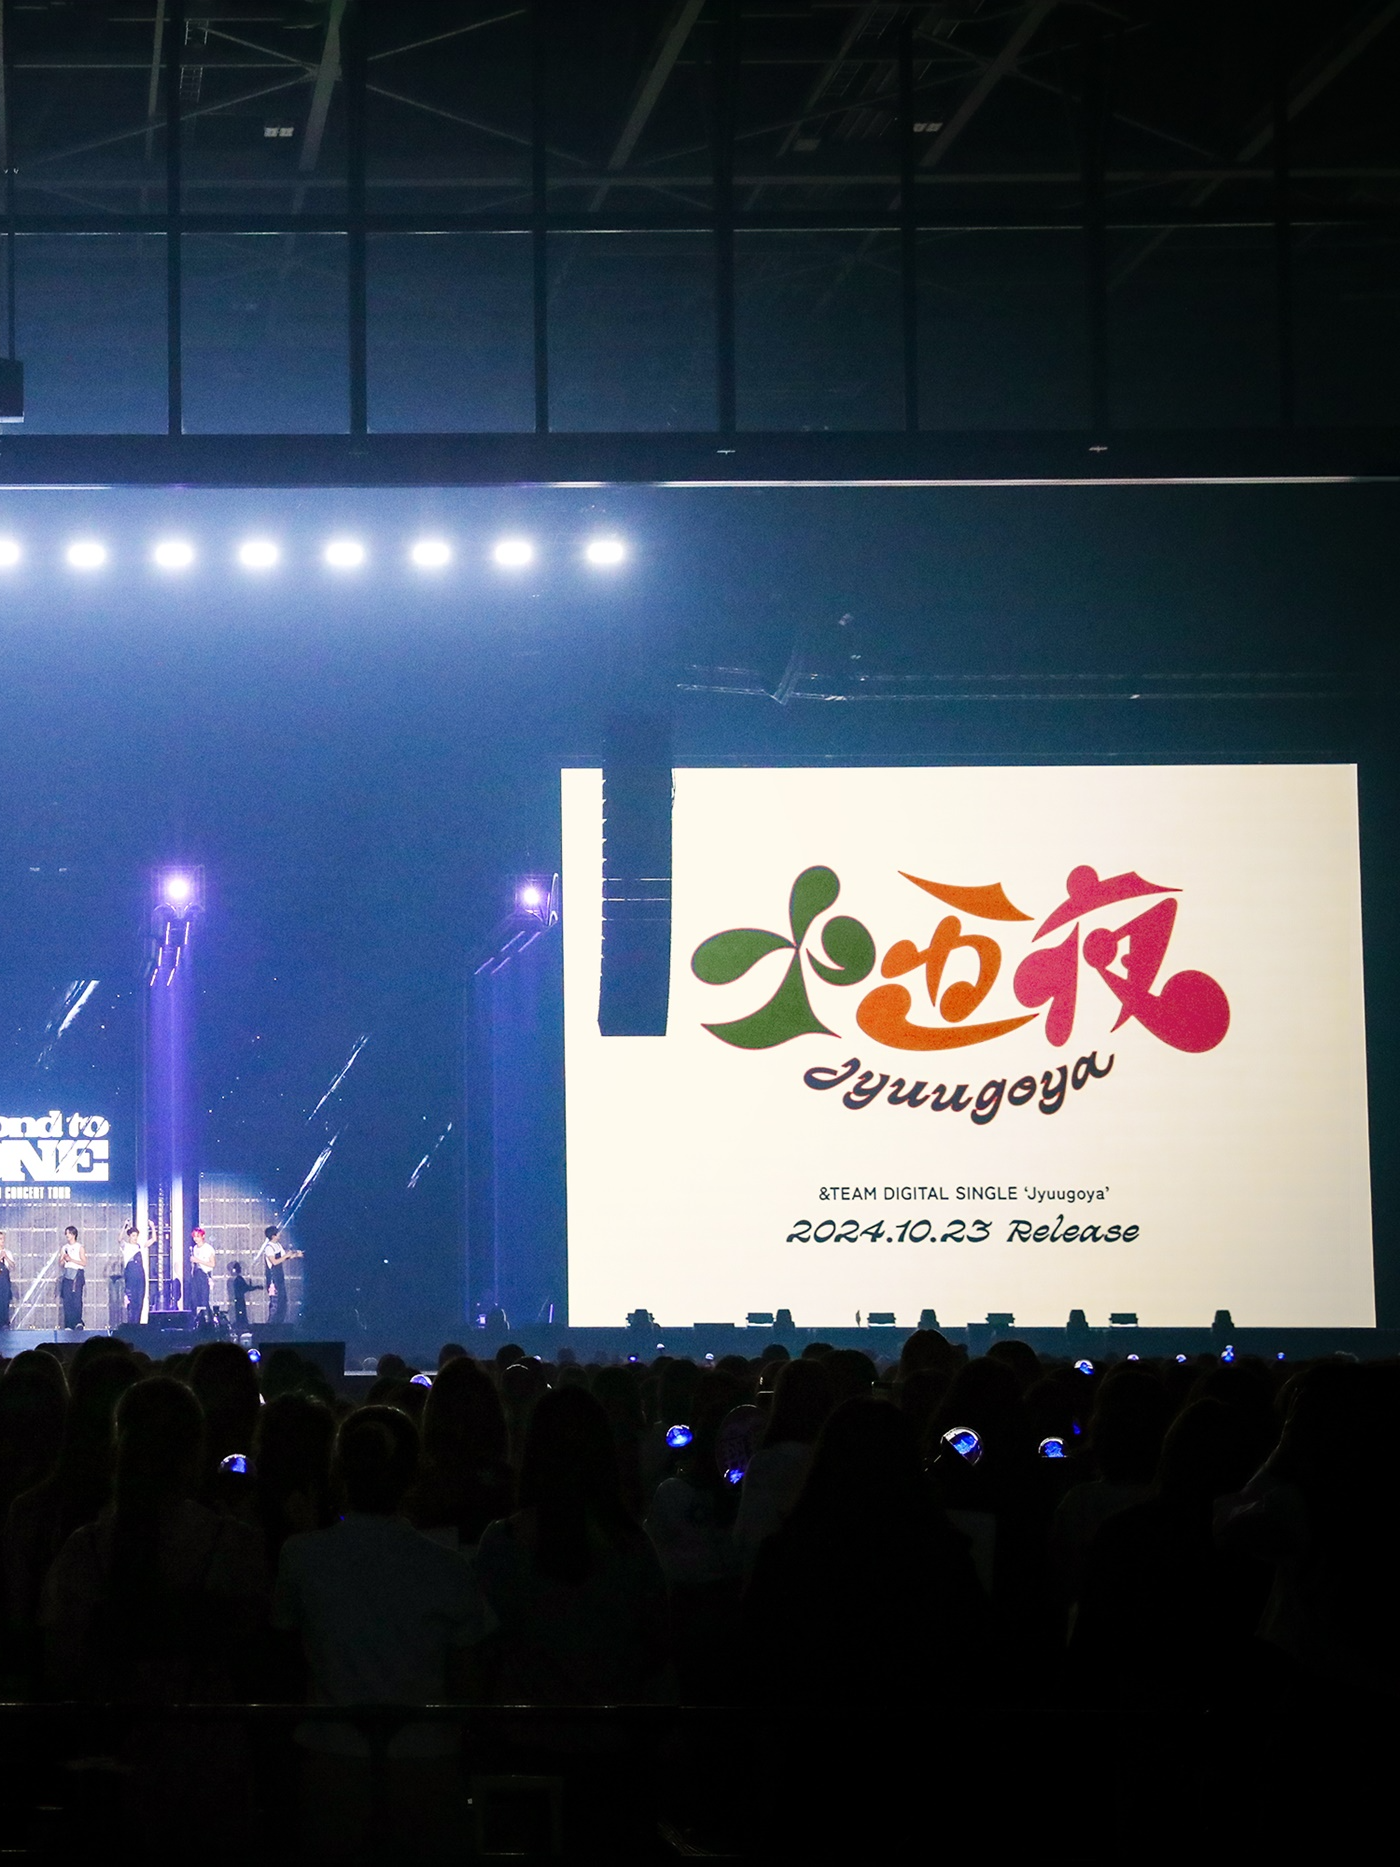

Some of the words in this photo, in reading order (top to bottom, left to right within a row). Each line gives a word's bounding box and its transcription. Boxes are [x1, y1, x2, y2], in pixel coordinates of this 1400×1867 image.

[803, 1050, 1115, 1125] Jyuugoya
[65, 1112, 110, 1138] to
[4, 1186, 45, 1200] CONCERT
[47, 1186, 71, 1200] TOUR
[818, 1186, 877, 1201] &TEAM
[884, 1186, 950, 1201] DIGITAL
[956, 1186, 1018, 1201] SINGLE
[785, 1218, 993, 1244] 2024.10.23
[1006, 1213, 1140, 1243] Release
